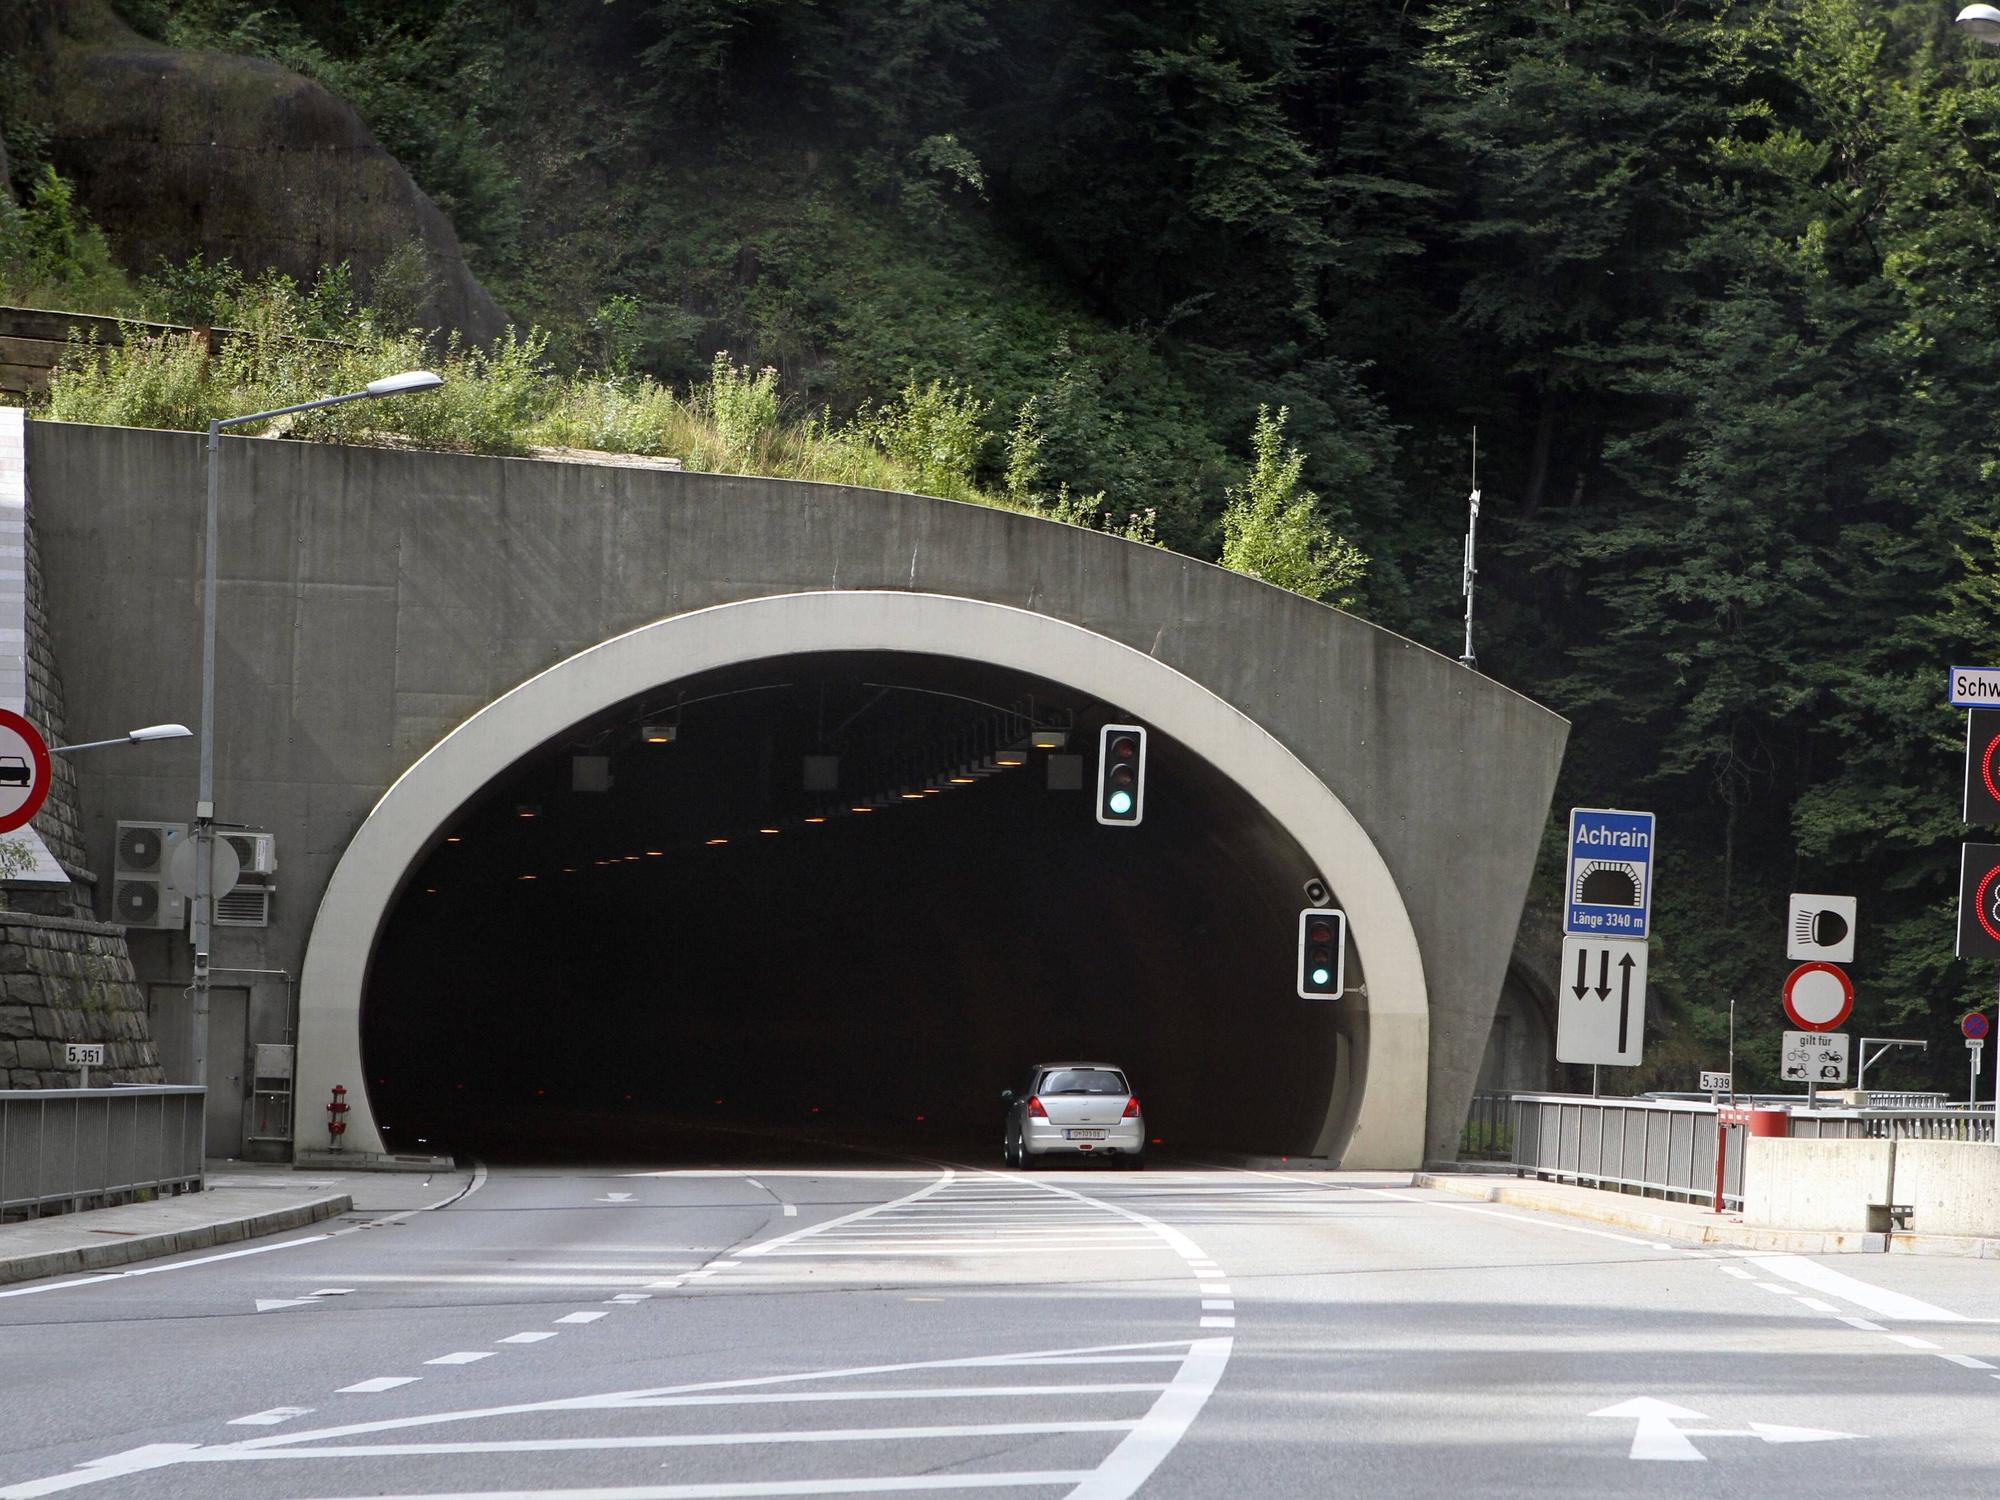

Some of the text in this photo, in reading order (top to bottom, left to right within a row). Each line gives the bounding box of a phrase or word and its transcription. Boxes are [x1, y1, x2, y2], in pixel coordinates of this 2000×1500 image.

[1576, 823, 1648, 848] Achrain
[1573, 911, 1643, 928] Länge 3340 m
[1800, 1035, 1832, 1047] gilt für
